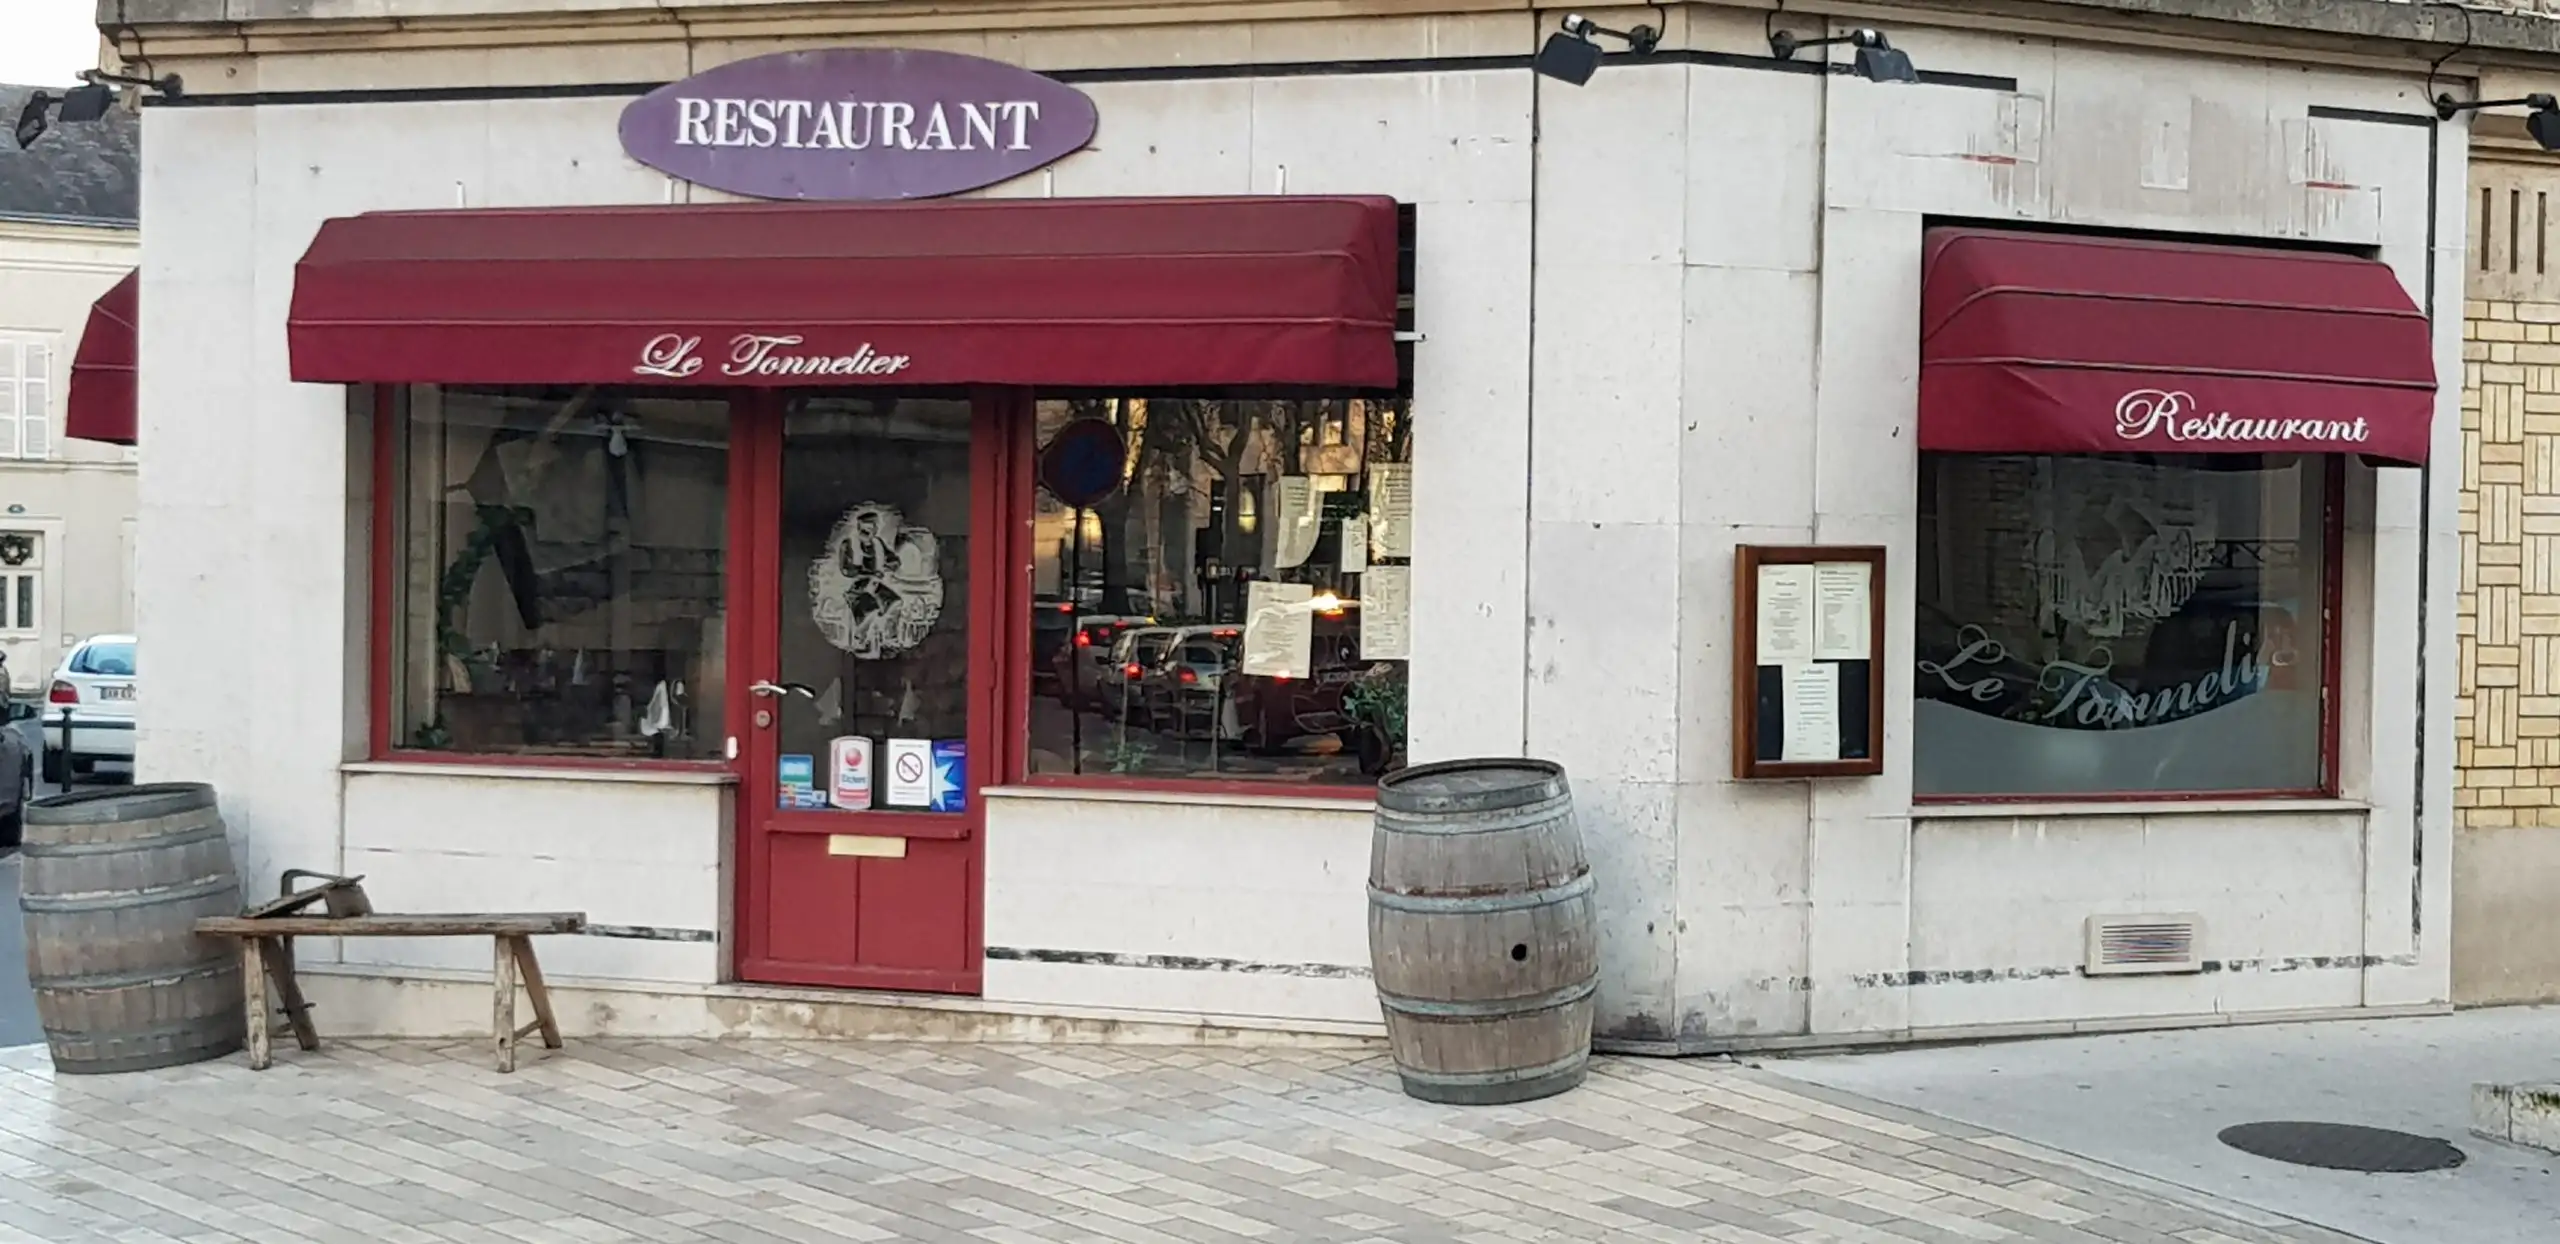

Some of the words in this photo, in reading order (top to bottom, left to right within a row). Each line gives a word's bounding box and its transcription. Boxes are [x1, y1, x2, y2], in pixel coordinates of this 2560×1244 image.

[675, 97, 1039, 152] RESTAURANT
[632, 333, 703, 377] Le
[721, 334, 911, 376] Tonnelier
[2115, 388, 2370, 441] Restaurant
[1918, 624, 2006, 701] Le
